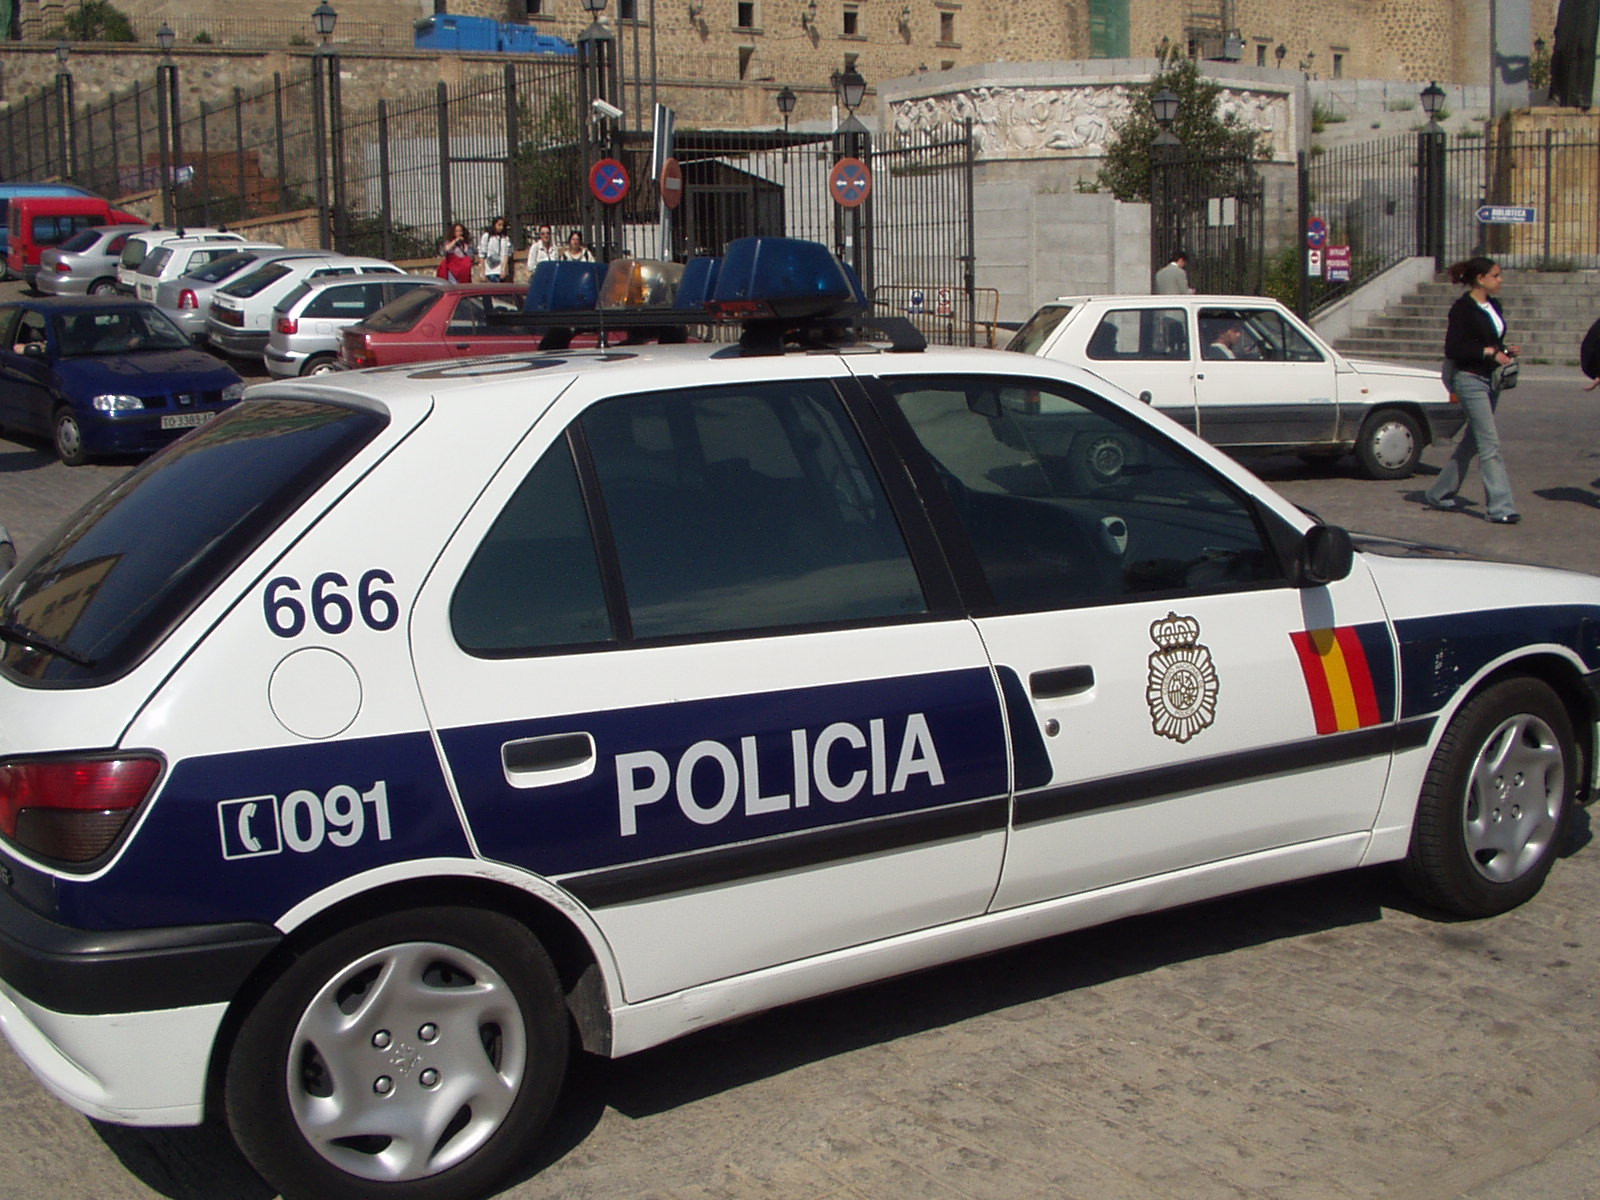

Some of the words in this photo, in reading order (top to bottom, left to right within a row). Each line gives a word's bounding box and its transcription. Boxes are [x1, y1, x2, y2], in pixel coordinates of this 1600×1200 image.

[1491, 208, 1527, 217] BIBLIOTECA
[263, 568, 399, 638] 666
[615, 712, 945, 837] POLICIA
[281, 780, 391, 853] 091
